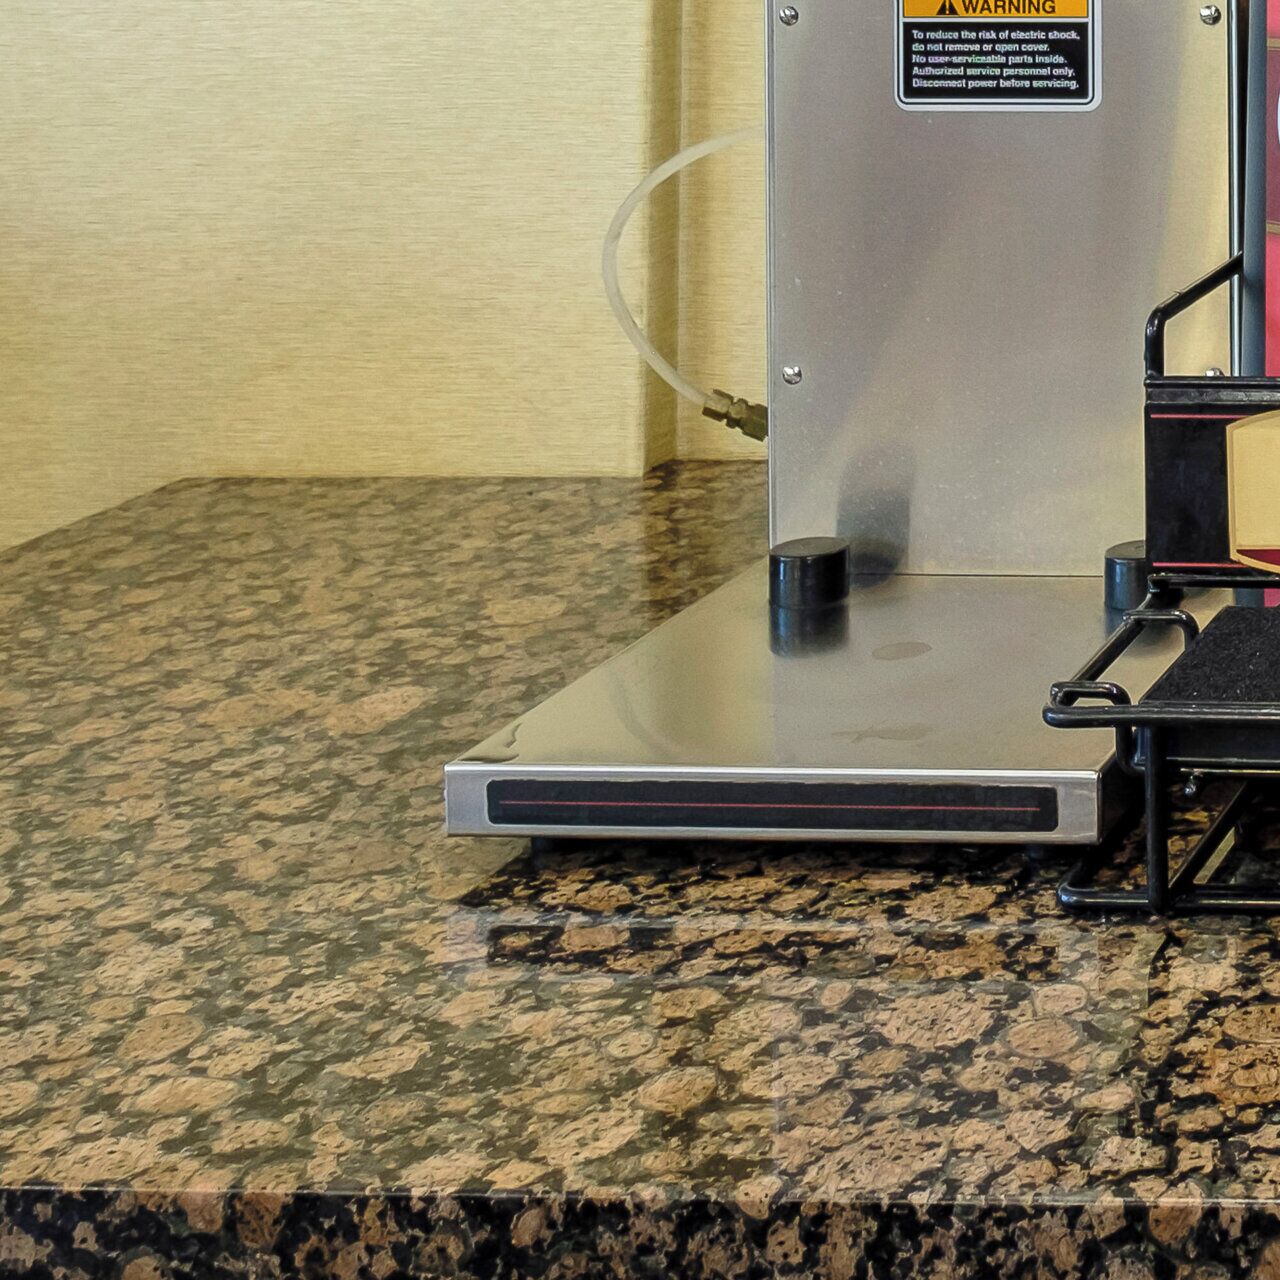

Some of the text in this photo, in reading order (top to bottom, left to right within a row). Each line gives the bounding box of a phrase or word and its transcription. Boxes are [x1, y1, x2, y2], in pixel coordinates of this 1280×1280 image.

[962, 0, 1056, 14] WARNING
[912, 30, 923, 39] To
[927, 30, 958, 39] reduce
[961, 30, 976, 39] the
[979, 30, 996, 39] risk
[1000, 30, 1009, 39] of
[1011, 30, 1045, 39] electric
[912, 43, 924, 51] do
[927, 43, 943, 51] not
[995, 44, 1019, 53] open
[912, 67, 963, 75] Authorized
[967, 67, 1000, 75] service
[1003, 67, 1050, 76] personnel
[912, 79, 966, 87] Disconnect
[968, 80, 997, 89] power
[1000, 79, 1030, 87] before
